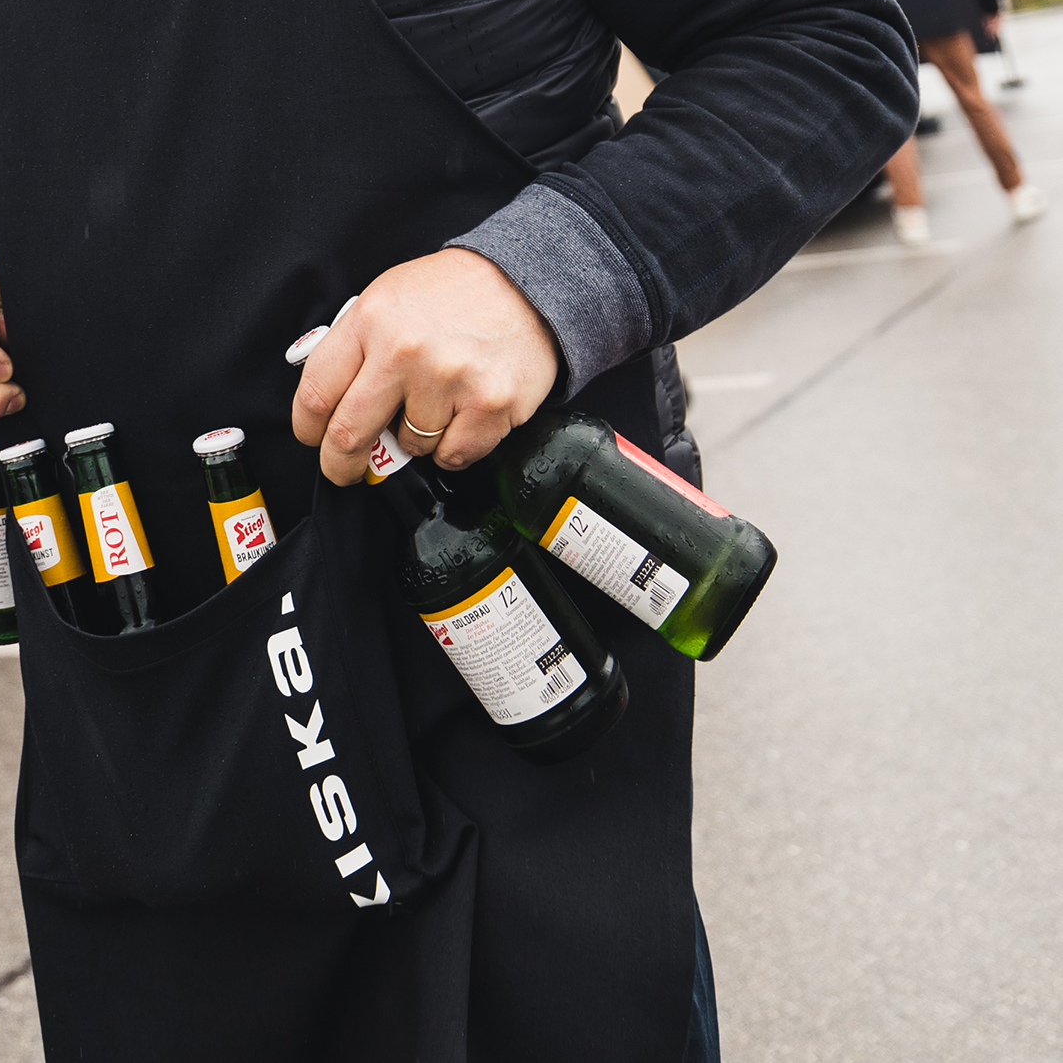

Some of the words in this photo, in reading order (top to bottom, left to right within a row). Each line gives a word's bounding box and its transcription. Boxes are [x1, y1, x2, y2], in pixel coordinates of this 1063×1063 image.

[21, 520, 44, 539] tiegl
[99, 510, 129, 569] ROT
[234, 513, 265, 545] Stiegl
[33, 548, 54, 561] KUNST
[451, 603, 490, 629] GOLDBRÄU
